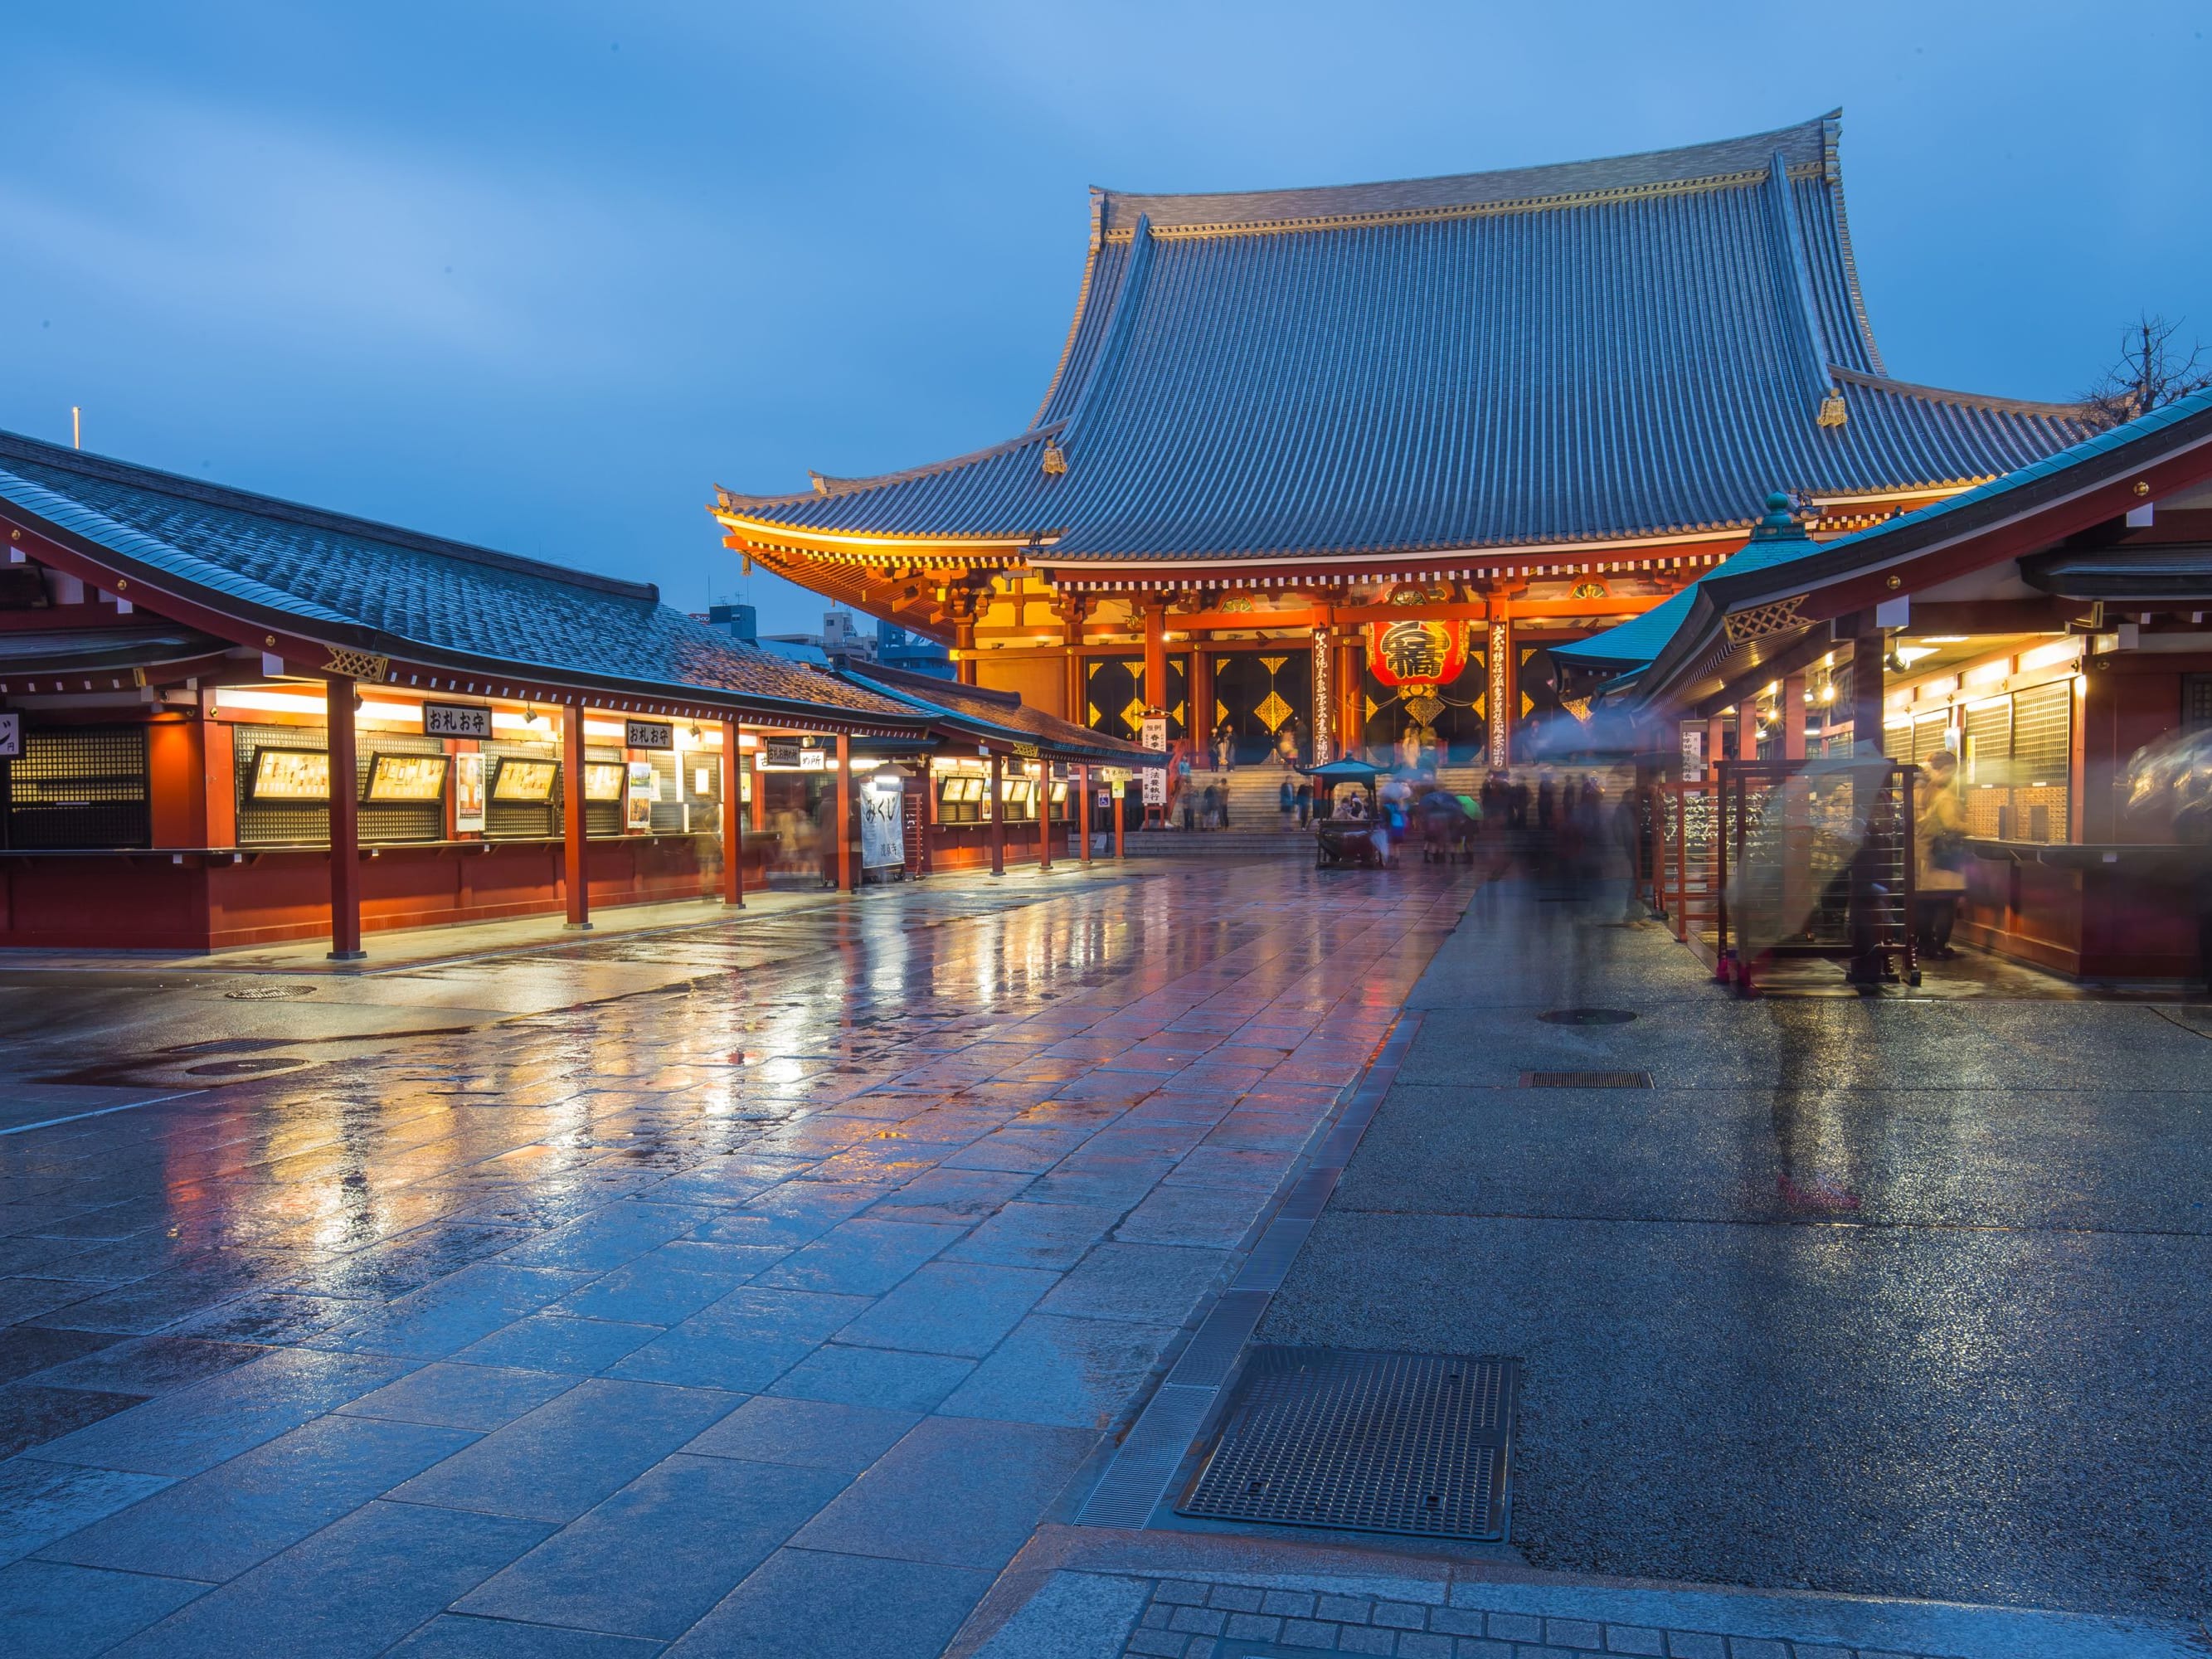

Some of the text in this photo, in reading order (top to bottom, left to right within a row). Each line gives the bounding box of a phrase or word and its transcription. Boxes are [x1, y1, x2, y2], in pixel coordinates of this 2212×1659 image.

[430, 709, 484, 733] お札お守
[630, 726, 668, 745] お札お守
